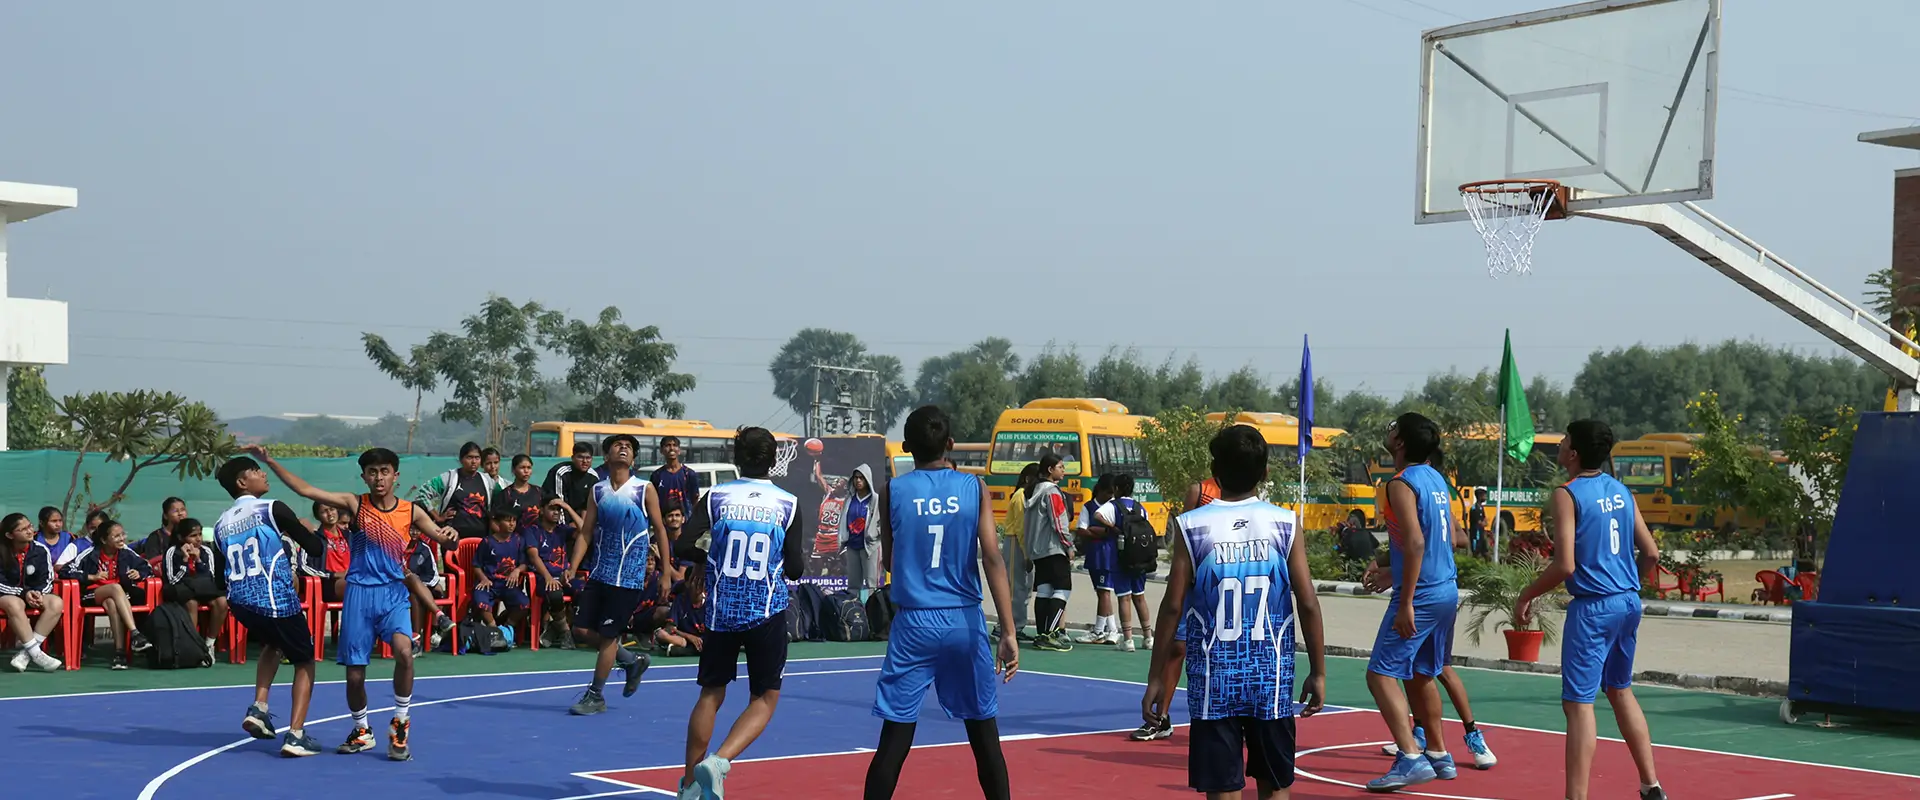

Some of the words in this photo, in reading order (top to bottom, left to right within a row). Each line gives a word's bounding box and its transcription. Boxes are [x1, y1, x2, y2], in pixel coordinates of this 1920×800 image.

[997, 432, 1013, 440] DELHI
[912, 496, 960, 516] T.G.S
[1509, 491, 1533, 502] PUBLIC
[1597, 494, 1625, 513] T.G.S
[217, 513, 265, 539] PUSHKAR
[719, 505, 772, 524] PRINCE
[774, 511, 786, 529] R
[821, 509, 841, 526] 23
[928, 524, 944, 568] 7
[1609, 517, 1620, 555] 6
[227, 536, 262, 581] 03
[722, 530, 771, 580] 09
[1213, 539, 1270, 565] NITIN
[812, 578, 843, 586] PUBLIC
[1216, 576, 1271, 641] 07
